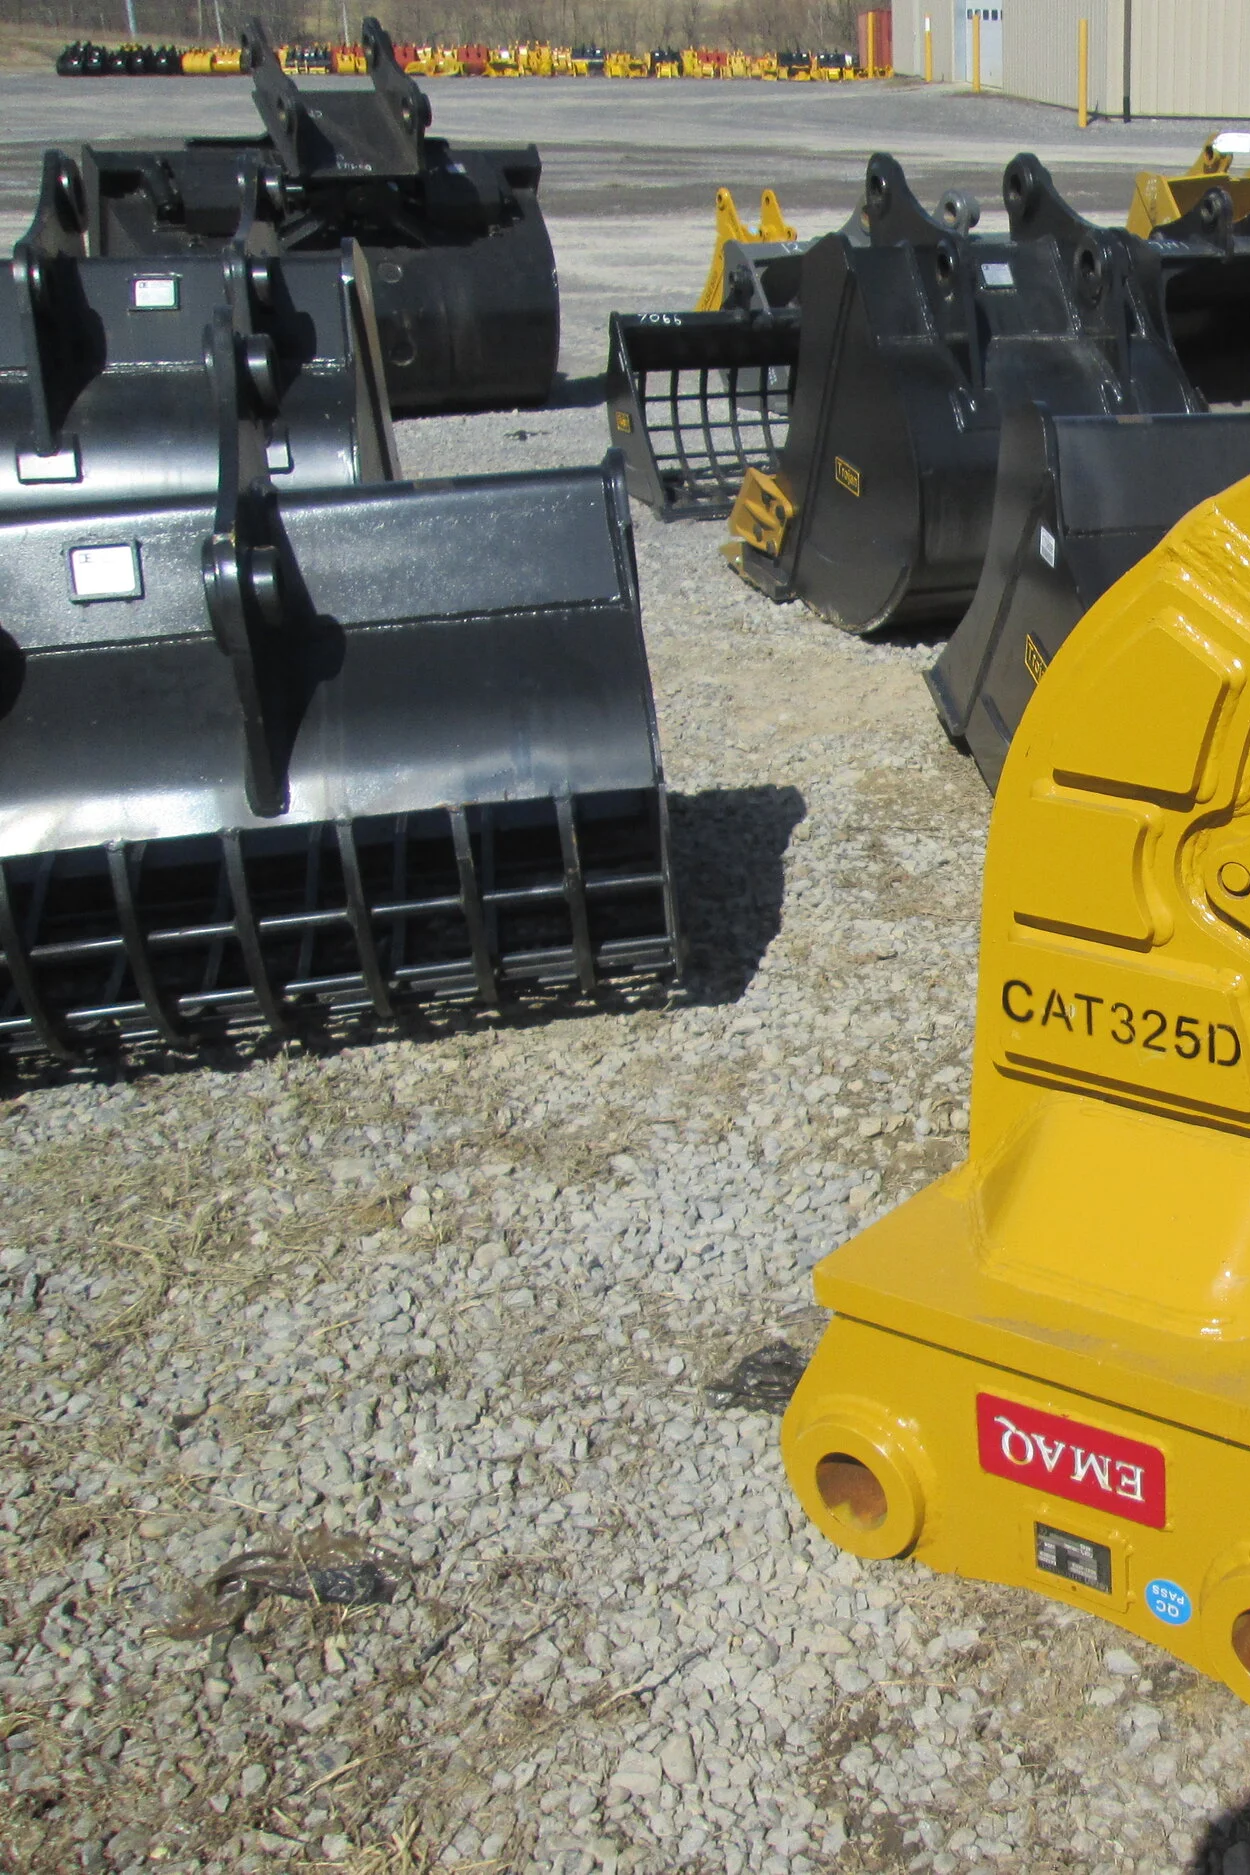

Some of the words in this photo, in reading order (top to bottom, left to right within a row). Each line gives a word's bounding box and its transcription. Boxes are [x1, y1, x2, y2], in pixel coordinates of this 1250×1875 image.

[637, 313, 682, 326] 7066
[837, 461, 858, 488] Trojan
[1028, 642, 1046, 681] Troj
[1002, 979, 1242, 1067] CAT325D
[994, 1415, 1146, 1502] EMAQ
[1152, 1584, 1185, 1605] PASS
[1156, 1599, 1180, 1618] QC
